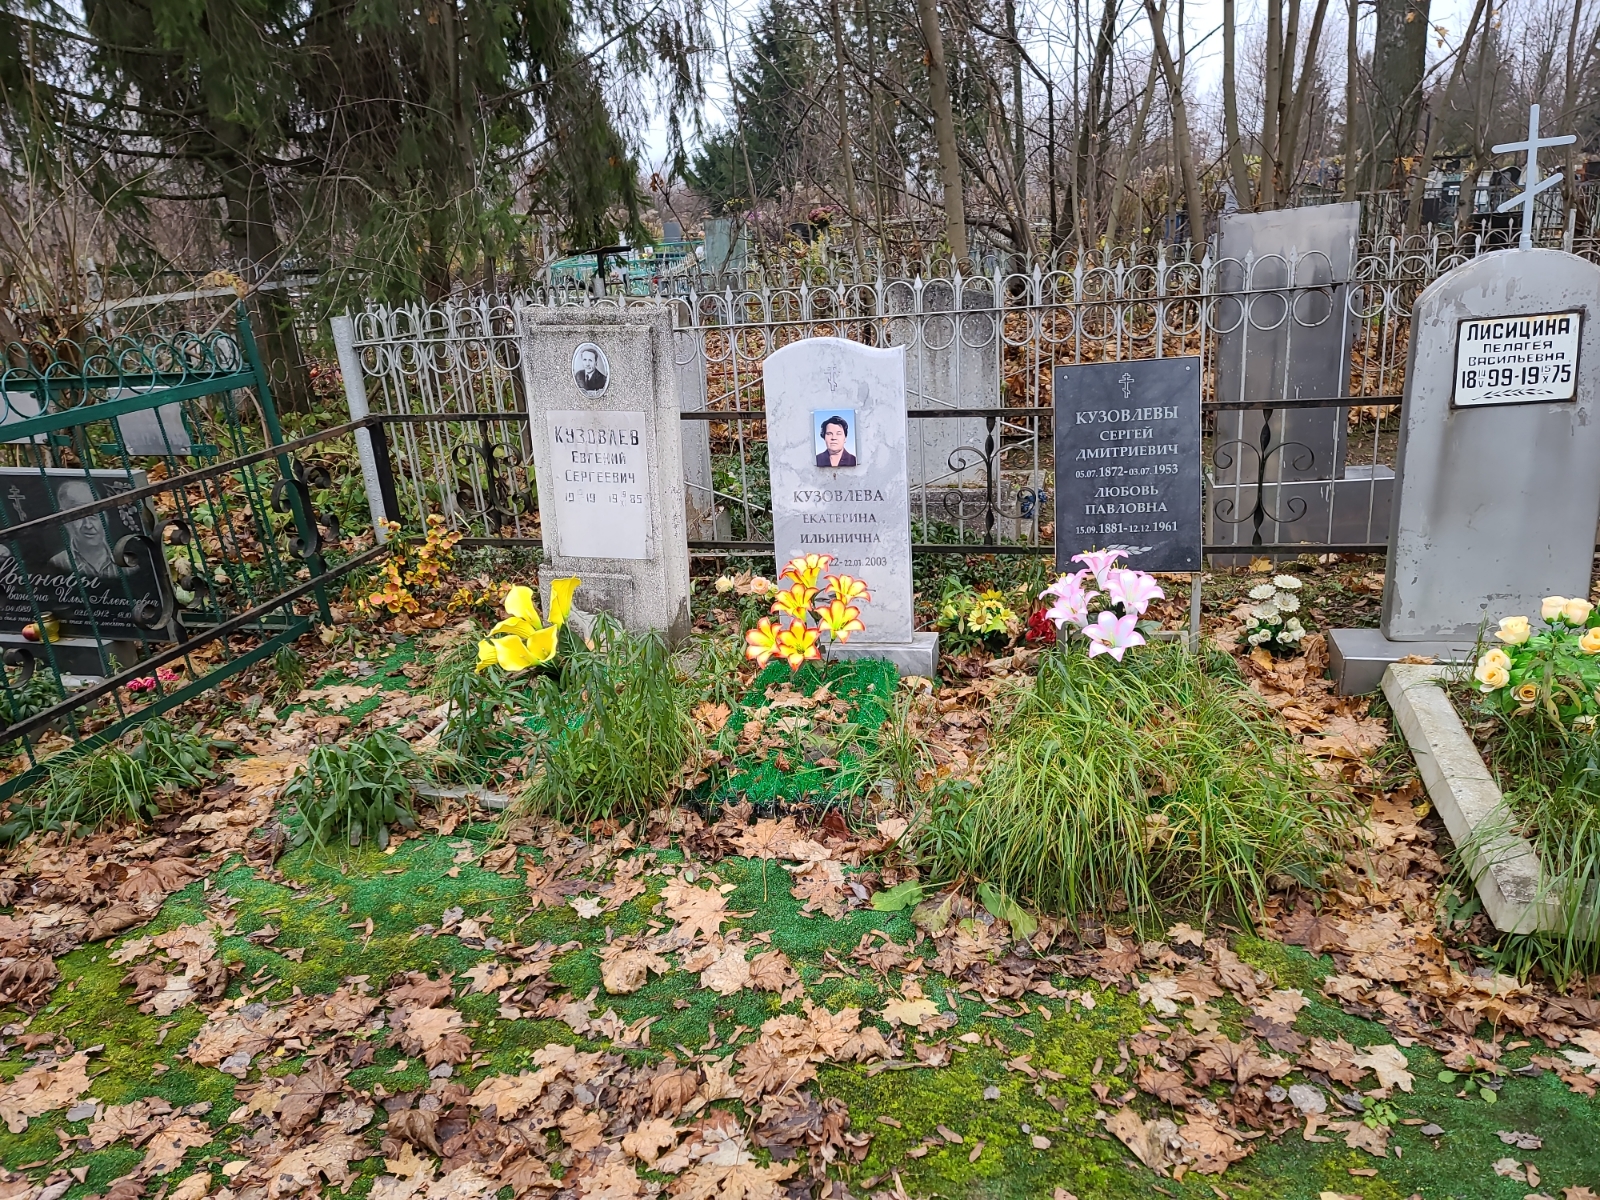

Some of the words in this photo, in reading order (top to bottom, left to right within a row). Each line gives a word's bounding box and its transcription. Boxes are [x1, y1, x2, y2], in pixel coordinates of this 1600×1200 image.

[1467, 318, 1570, 341] ЛИСИЦИНА
[1483, 340, 1553, 353] ПЕЛАГЕЯ
[1468, 352, 1565, 366] ВАСИЛЬЕВНА
[1076, 406, 1179, 425] КУЗОВЛЕВЫ
[554, 426, 639, 446] КУЗОВЛЕВ
[1100, 426, 1153, 441] СЕРГЕЙ
[571, 450, 626, 465] ЕВГЕНИЙ
[1076, 444, 1179, 461] ДМИТРИЕВИЧ
[565, 469, 635, 484] СЕРГЕЕВИЧ
[793, 489, 885, 503] КУЗОВЛЕВА
[1094, 485, 1159, 497] ЛЮБОВЬ
[1085, 502, 1168, 515] ПАВЛОВНА
[802, 513, 877, 524] ЕКАТЕРИНА
[800, 533, 881, 544] ИЛЬИНИЧНА
